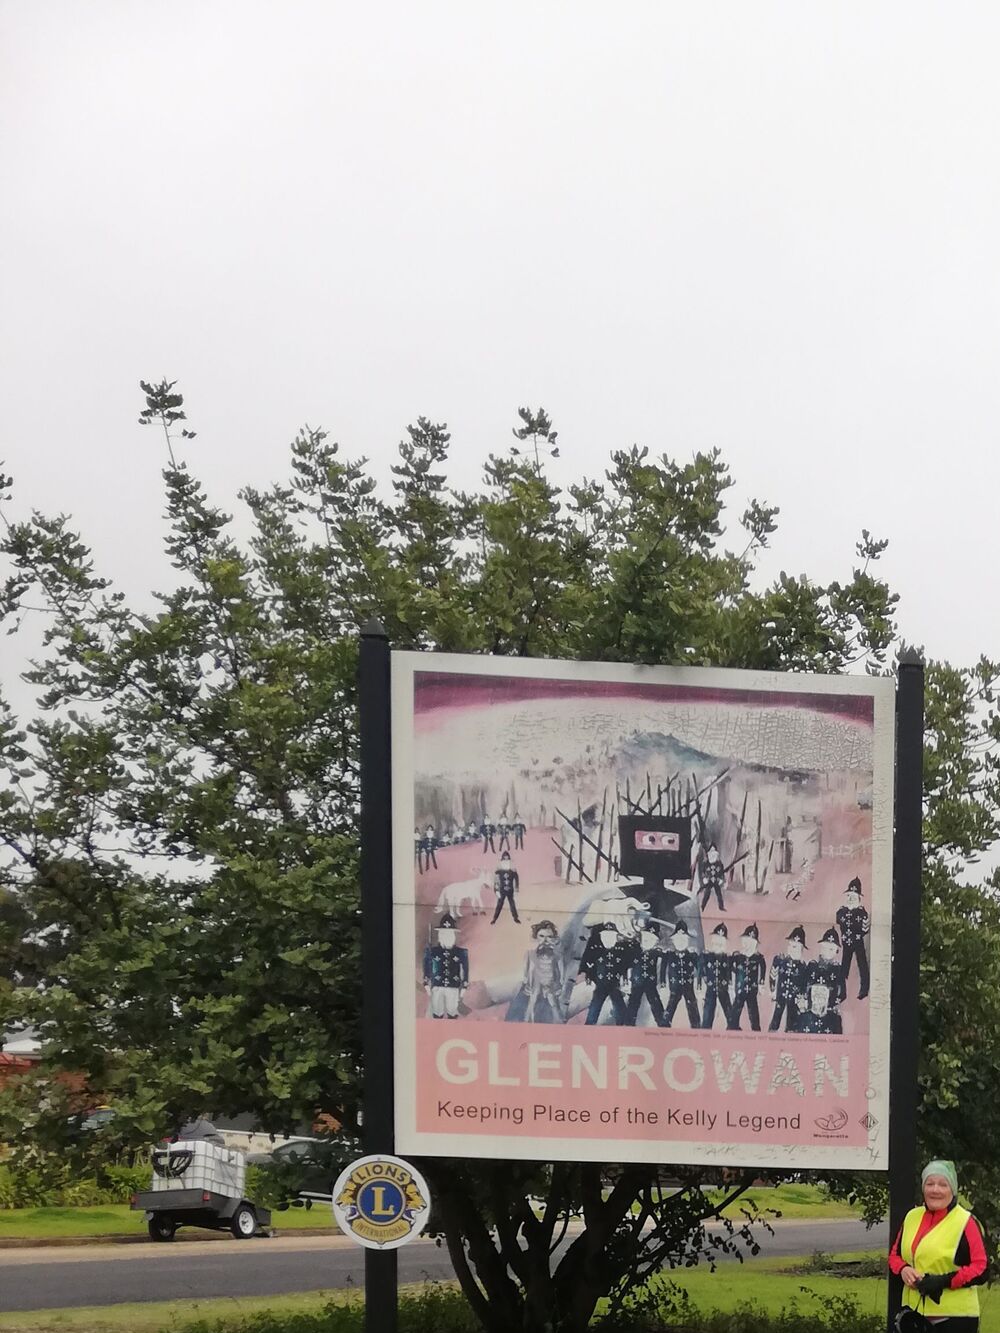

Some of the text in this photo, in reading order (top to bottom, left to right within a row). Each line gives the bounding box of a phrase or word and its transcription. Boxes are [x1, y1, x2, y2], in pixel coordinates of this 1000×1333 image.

[435, 1038, 849, 1098] GLENROWAN
[437, 1100, 801, 1132] Keeping Place of the Kelly Legend
[356, 1164, 408, 1183] LIONS
[371, 1186, 395, 1216] L
[354, 1222, 408, 1239] INTERNATIONAL
